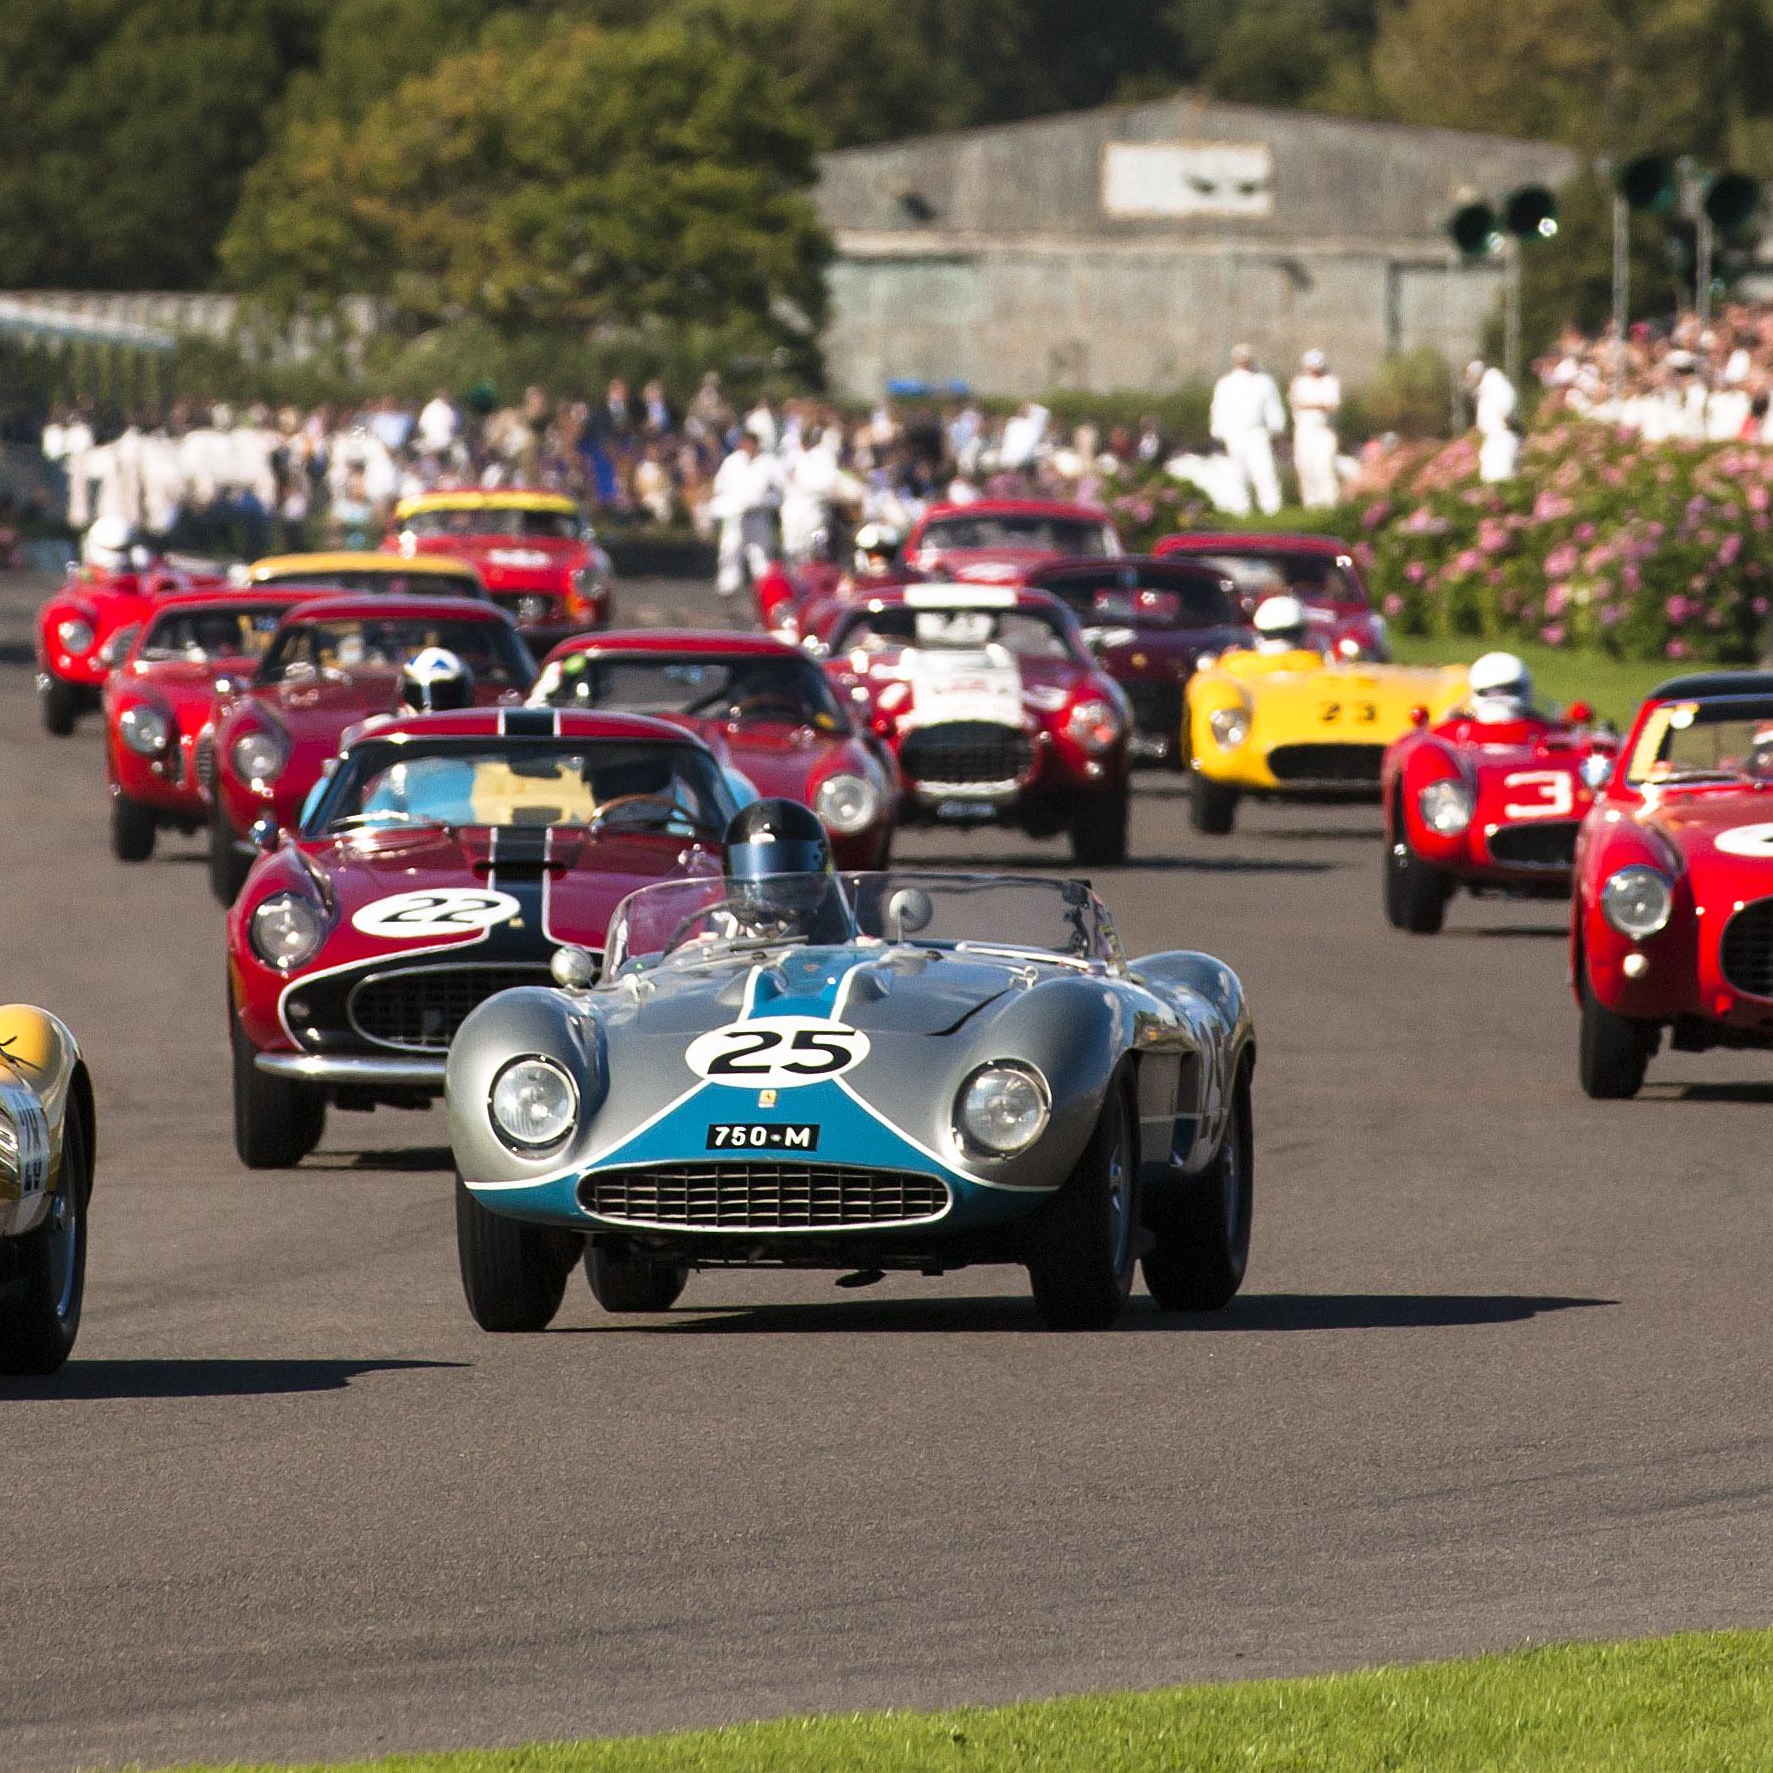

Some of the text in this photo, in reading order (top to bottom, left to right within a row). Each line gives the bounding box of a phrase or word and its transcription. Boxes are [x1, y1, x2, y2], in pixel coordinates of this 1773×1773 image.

[1319, 700, 1380, 726] 23
[1504, 770, 1574, 818] 3
[379, 896, 502, 924] 22
[707, 1029, 855, 1075] 25
